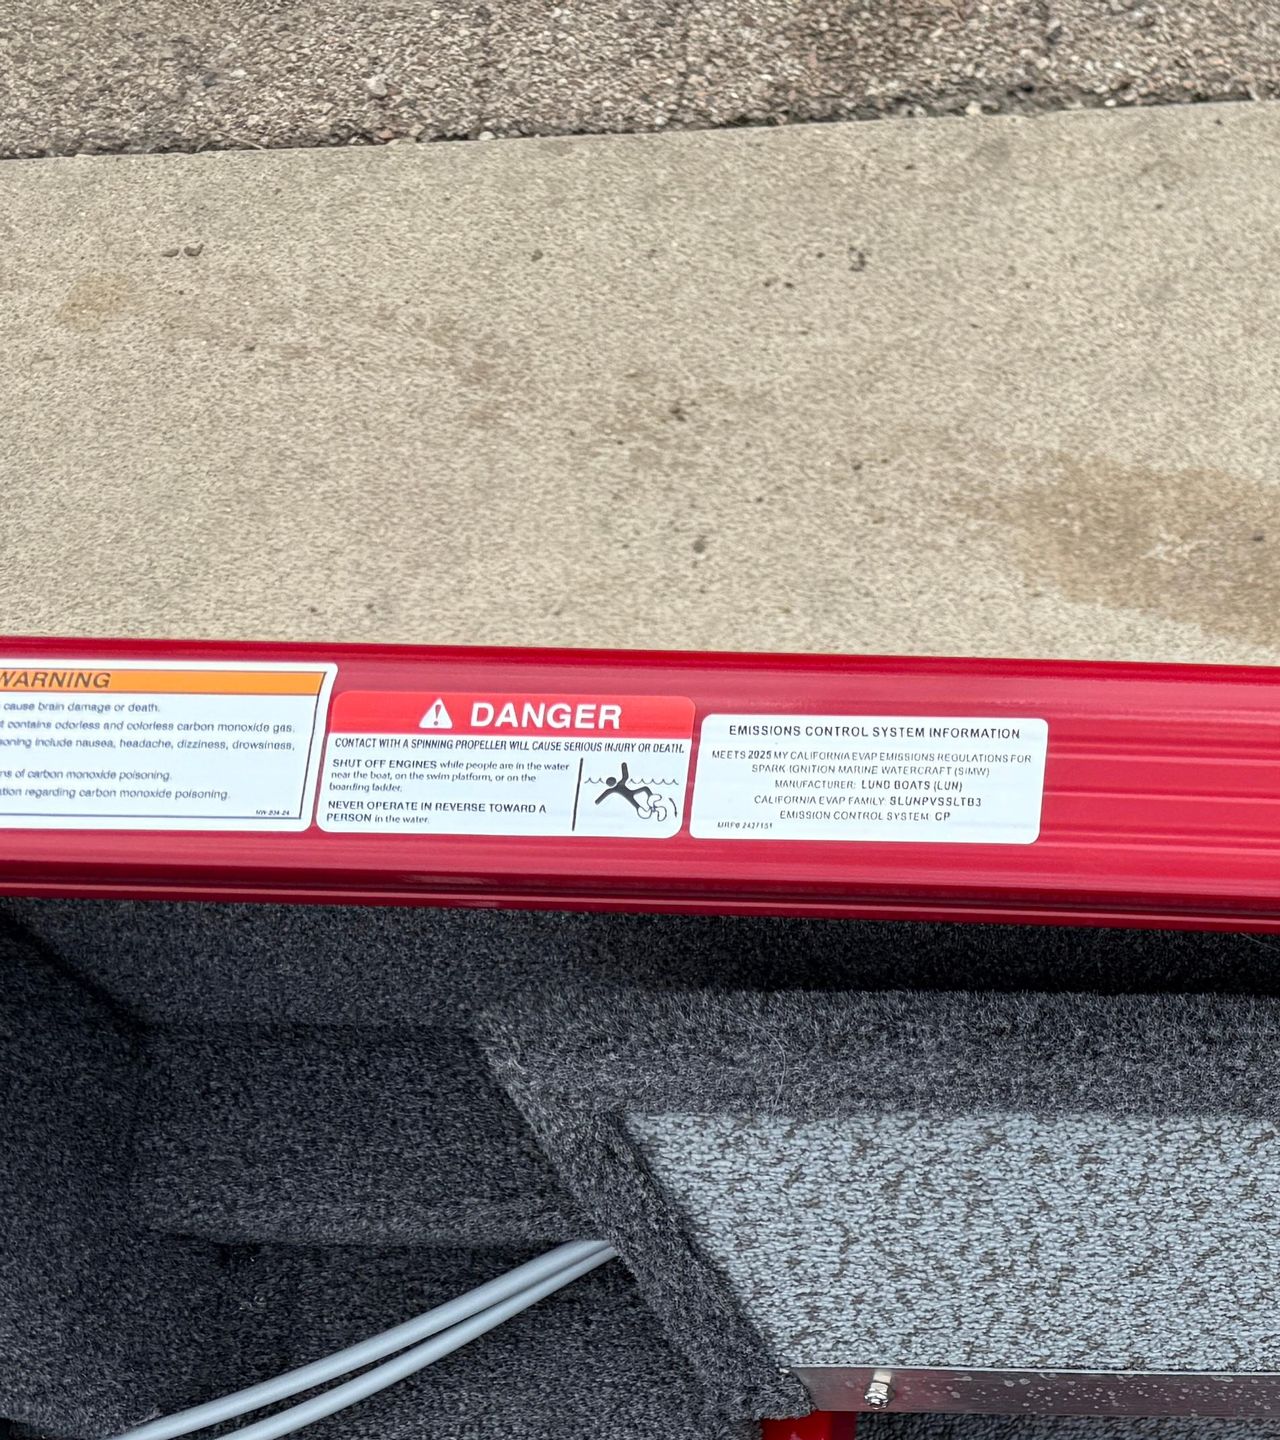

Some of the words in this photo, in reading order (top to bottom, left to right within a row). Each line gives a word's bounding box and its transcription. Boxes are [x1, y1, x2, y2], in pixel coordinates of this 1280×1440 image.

[3, 703, 35, 711] cause
[38, 702, 65, 711] brain
[67, 703, 111, 714] damage
[114, 704, 125, 712] or
[128, 703, 160, 713] death.
[470, 702, 622, 730] DANGER
[7, 721, 52, 729] contains
[55, 720, 100, 730] odorless
[103, 721, 124, 731] and
[126, 721, 174, 731] colorless
[177, 721, 214, 732] carbon
[217, 722, 270, 733] monoxide
[273, 724, 295, 734] gas.
[729, 725, 801, 736] EMISSIONS
[805, 726, 869, 737] CONTROL
[872, 726, 925, 738] SYSTEM
[929, 727, 1021, 739] INFORMATION
[35, 737, 73, 747] include
[75, 739, 116, 749] nausea,
[119, 738, 174, 749] headache,
[177, 739, 229, 750] dizziness,
[232, 740, 295, 751] drowsiness,
[334, 738, 377, 748] CONTACT
[379, 738, 400, 748] WITH
[402, 738, 409, 748] A
[411, 738, 453, 749] SPINNING
[455, 739, 507, 750] PROPELLER
[509, 740, 530, 751] WILL
[532, 741, 561, 751] CAUSE
[563, 741, 603, 752] SERIOUS
[604, 742, 636, 752] INJURY
[637, 743, 651, 753] OR
[653, 743, 684, 753] DEATH.
[712, 750, 746, 759] MEETS
[748, 750, 772, 760] 2025
[774, 751, 788, 760] MY
[790, 751, 850, 761] CALIFORNIA
[852, 752, 878, 762] EVAP
[879, 752, 935, 762] EMISSIONS
[937, 753, 1008, 763] REGULATIONS
[1010, 754, 1032, 763] FOR
[332, 759, 362, 768] SHUT
[364, 759, 386, 768] OFF
[389, 759, 437, 769] ENGINES
[440, 760, 464, 770] while
[465, 760, 498, 772] people
[499, 762, 514, 770] are
[516, 761, 525, 770] in
[527, 761, 542, 770] the
[543, 762, 570, 771] water
[838, 765, 878, 775] MARINE
[881, 766, 952, 775] WATERCRAFT
[954, 767, 990, 778] (SIMW)
[15, 769, 26, 779] of
[27, 769, 63, 779] carbon
[66, 769, 117, 779] monoxide
[118, 770, 172, 782] poisoning.
[331, 771, 350, 779] near
[353, 770, 368, 779] the
[370, 770, 393, 780] boat,
[395, 772, 407, 780] on
[409, 771, 425, 780] the
[426, 771, 450, 781] swim
[451, 771, 493, 782] platform,
[495, 773, 505, 781] or
[506, 773, 519, 782] on
[521, 773, 537, 782] the
[329, 782, 370, 793] boarding
[372, 782, 403, 792] ladder.
[775, 779, 856, 789] MANUFACTURER:
[861, 780, 891, 789] LUND
[894, 780, 931, 790] BOATS
[933, 781, 963, 792] (LUN)
[25, 787, 77, 799] regarding
[78, 788, 117, 798] carbon
[119, 788, 172, 799] monoxide
[174, 789, 231, 801] poisoning.
[754, 795, 817, 804] CALIFORNIA
[819, 796, 846, 805] EVAP
[328, 800, 364, 810] NEVER
[366, 801, 418, 811] OPERATE
[420, 802, 432, 811] IN
[435, 802, 486, 812] REVERSE
[489, 803, 536, 813] TOWARD
[538, 804, 547, 813] A
[326, 813, 372, 822] PERSON
[374, 813, 384, 822] in
[385, 814, 400, 823] the
[402, 814, 429, 824] water.
[780, 810, 831, 820] EMISSION
[833, 811, 883, 820] CONTROL
